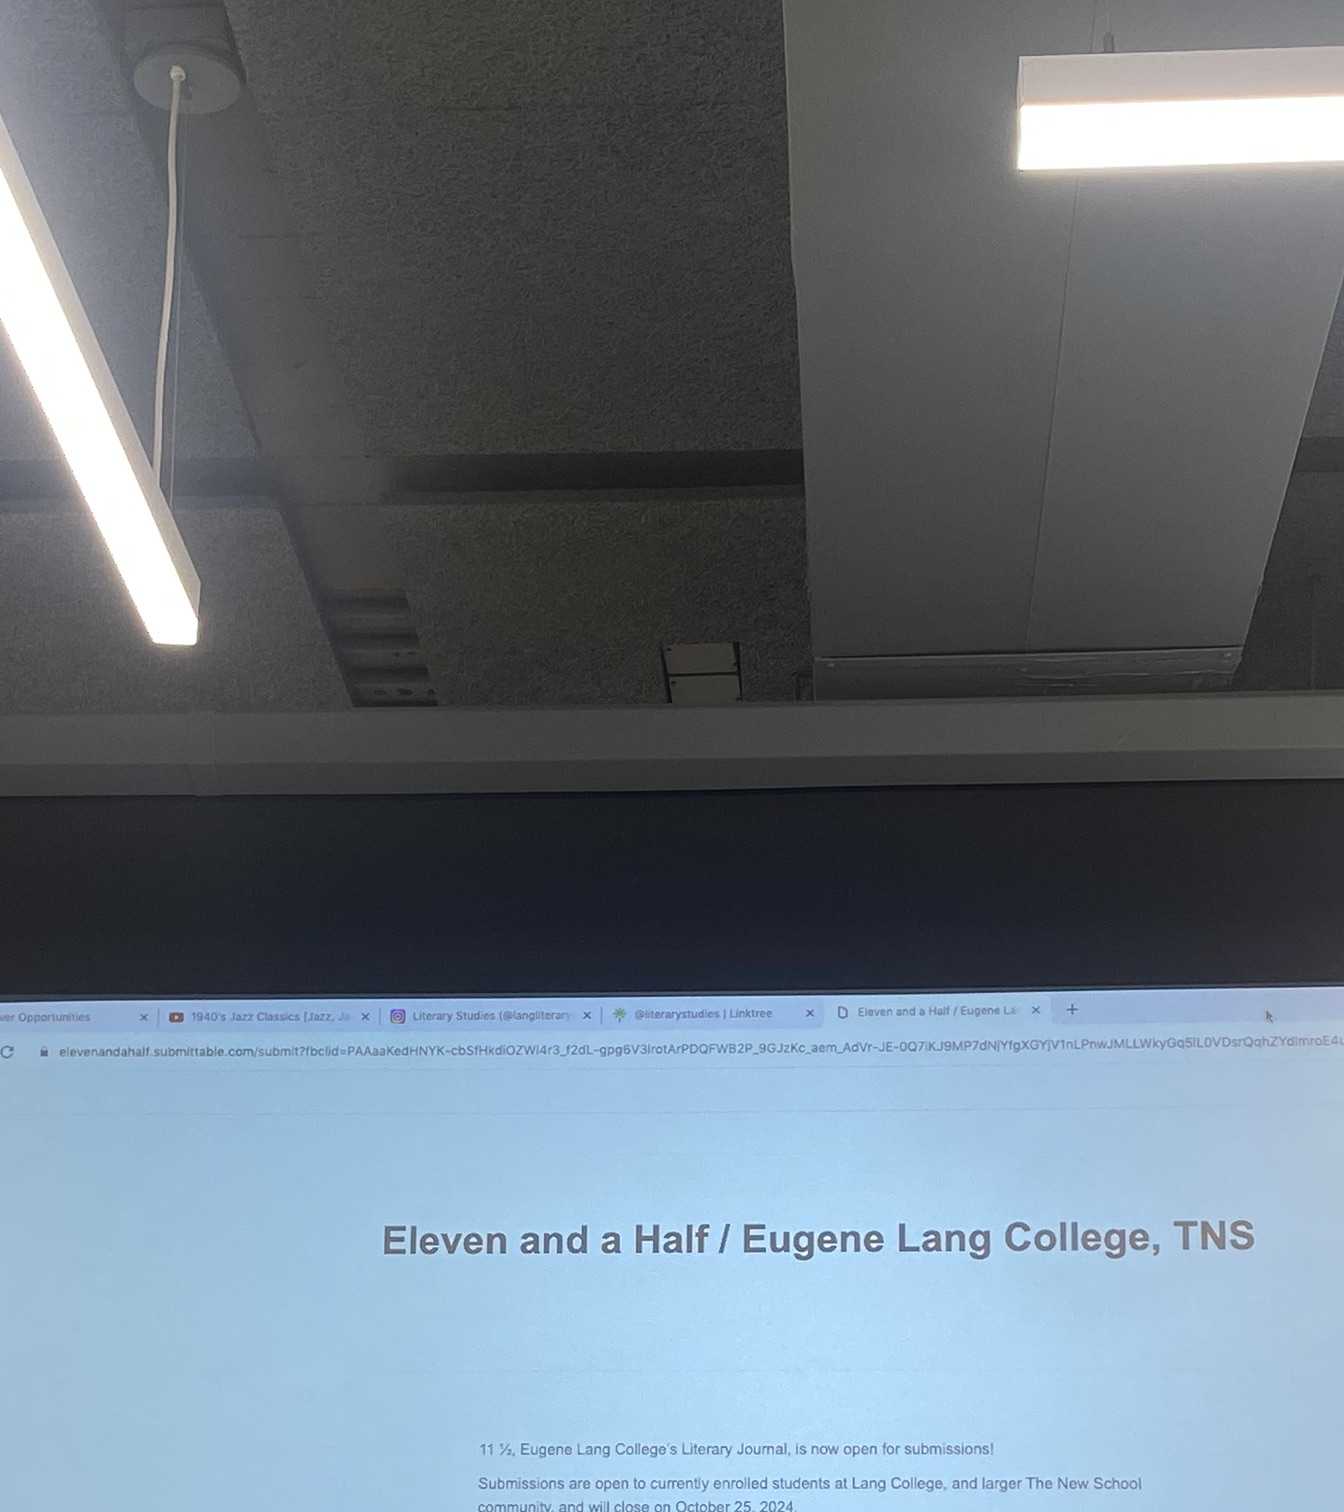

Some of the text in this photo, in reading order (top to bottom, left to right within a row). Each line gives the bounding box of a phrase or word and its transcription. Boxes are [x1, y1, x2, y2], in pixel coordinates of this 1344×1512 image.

[16, 1011, 91, 1025] Opportunities
[190, 1011, 227, 1023] 1940's
[228, 1012, 254, 1022] Jazz
[255, 1011, 301, 1022] Classics
[411, 1010, 454, 1024] Literary
[454, 1010, 496, 1023] Studies
[633, 1008, 721, 1022] @literarystudies
[728, 1008, 773, 1019] Linktree
[856, 1006, 894, 1018] Eleven
[894, 1006, 917, 1017] and
[917, 1008, 926, 1017] a
[927, 1004, 951, 1017] Half
[958, 1005, 1001, 1018] Eugene
[382, 1219, 1255, 1262] Eleven and a Half / Eugene Lang College, TNS
[478, 1443, 494, 1456] 11
[519, 1442, 573, 1459] Eugene
[575, 1442, 611, 1459] Lang
[613, 1442, 678, 1459] College's
[680, 1442, 733, 1460] Literary
[735, 1441, 792, 1457] Journal,
[794, 1441, 808, 1455] is
[809, 1444, 840, 1455] now
[841, 1444, 878, 1458] open
[880, 1441, 901, 1456] for
[902, 1441, 994, 1456] submissions!
[476, 1476, 1143, 1493] Submissions are open to currently enrolled students at Lang College, and larger The New School
